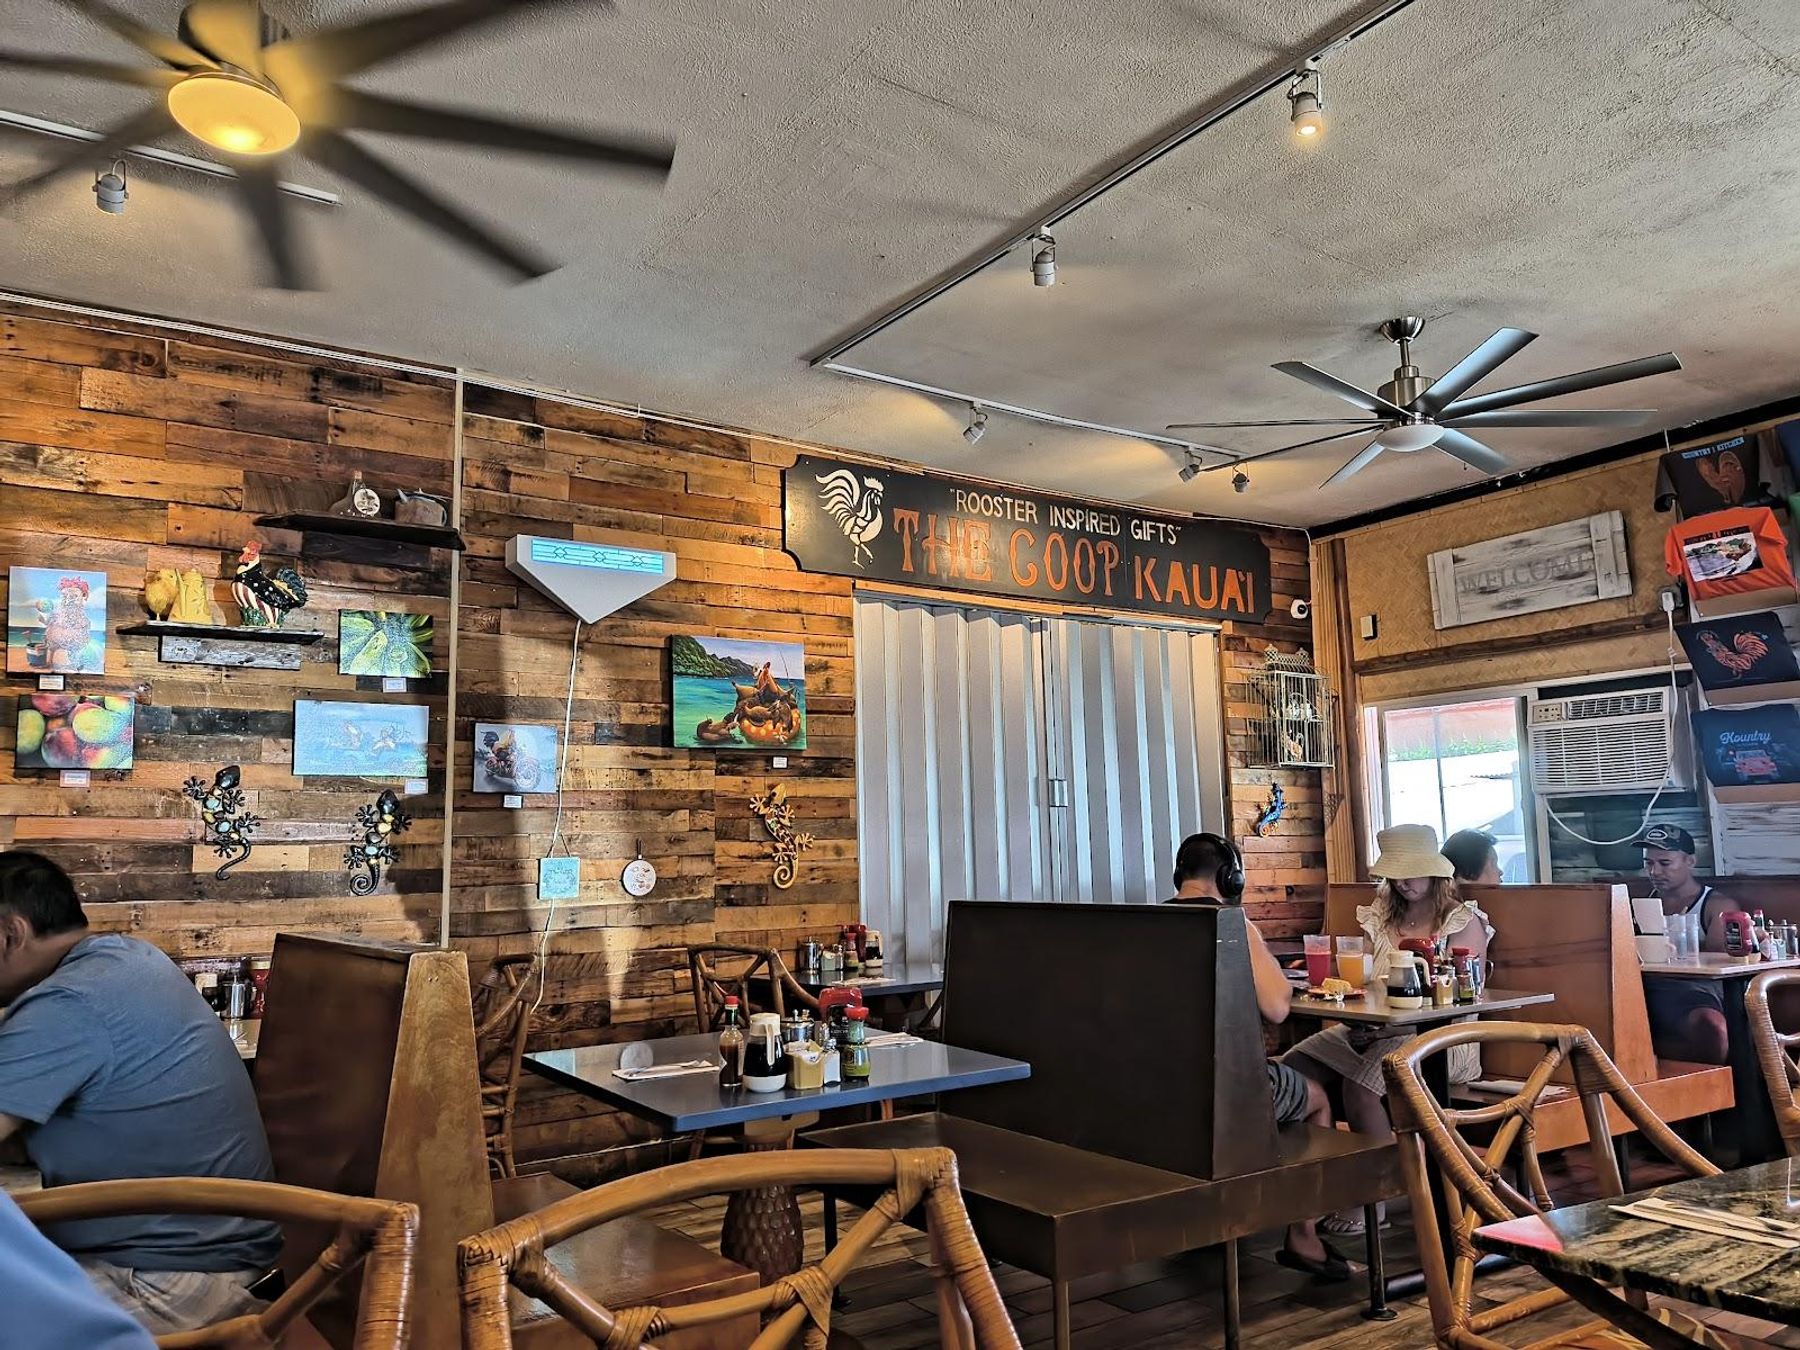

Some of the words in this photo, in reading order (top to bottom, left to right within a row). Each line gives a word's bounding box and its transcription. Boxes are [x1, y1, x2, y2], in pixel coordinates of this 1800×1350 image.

[1049, 505, 1121, 537] INSPIRED
[893, 507, 993, 582] THE
[1009, 527, 1121, 598] COOP
[1456, 552, 1594, 593] WELCOME
[1720, 730, 1772, 744] Kountry
